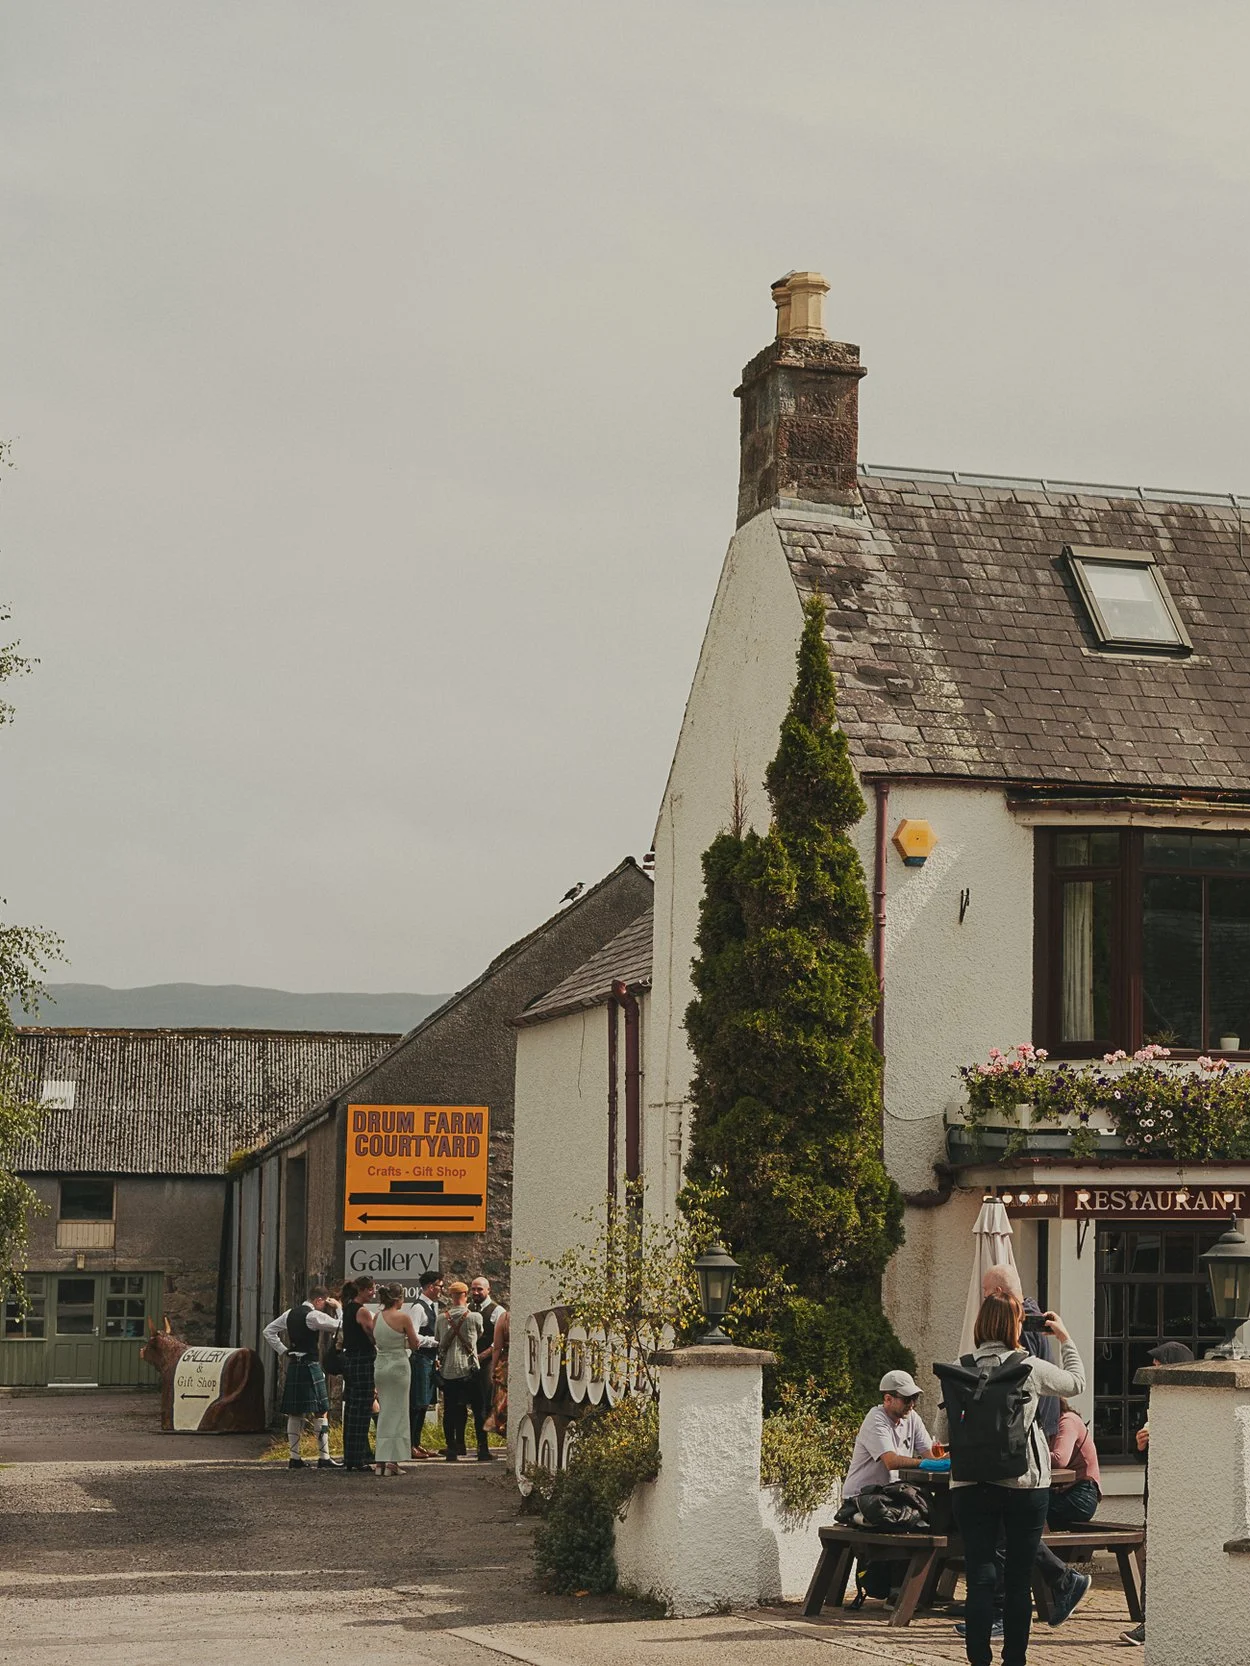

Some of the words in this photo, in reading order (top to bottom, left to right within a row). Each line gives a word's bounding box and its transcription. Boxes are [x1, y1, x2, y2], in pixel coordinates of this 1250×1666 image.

[353, 1111, 415, 1133] DRUM
[424, 1112, 483, 1134] FARM
[355, 1134, 480, 1157] COURTYARD
[367, 1165, 402, 1177] Crafts
[413, 1165, 433, 1177] Gift
[436, 1166, 466, 1179] Shop
[1074, 1190, 1246, 1211] RESTAURANT
[350, 1247, 434, 1275] Gallery
[183, 1350, 230, 1362] GALLERY
[196, 1364, 203, 1373] &
[178, 1376, 193, 1387] Gift
[197, 1377, 216, 1391] Shop
